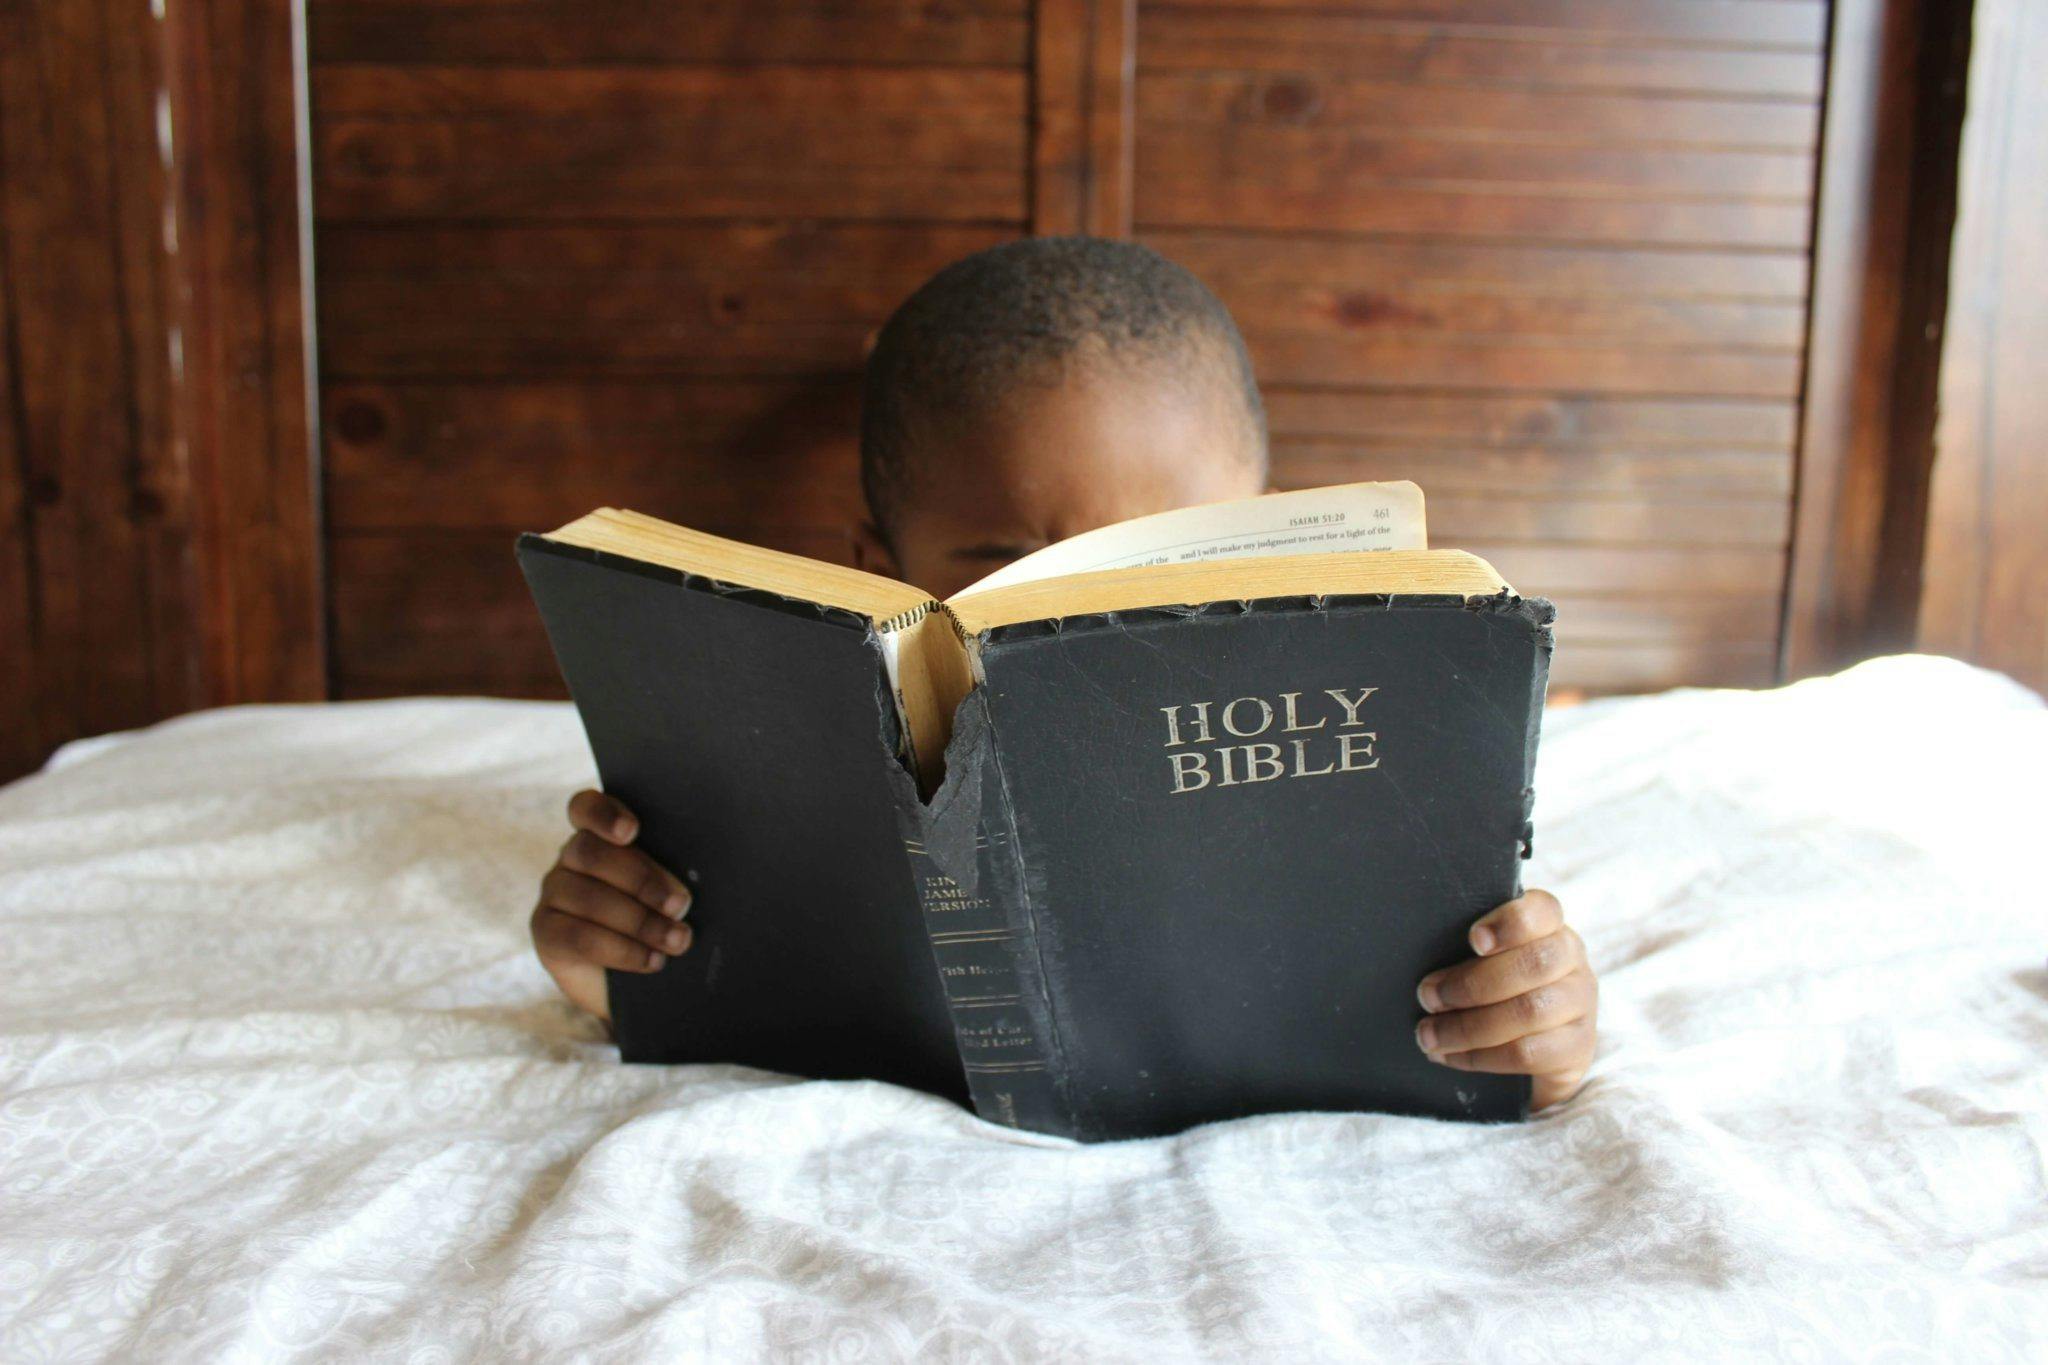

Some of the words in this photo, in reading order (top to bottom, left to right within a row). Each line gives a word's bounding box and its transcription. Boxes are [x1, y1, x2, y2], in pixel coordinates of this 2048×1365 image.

[1289, 515, 1319, 527] ISAIAH
[1322, 512, 1346, 523] 51:20
[1373, 507, 1390, 519] 461
[1180, 549, 1196, 560] and
[1202, 545, 1218, 555] will
[1219, 543, 1242, 553] make
[1243, 543, 1256, 551] my
[1257, 536, 1297, 549] judgment
[1298, 535, 1308, 543] to
[1326, 530, 1338, 540] for
[1345, 528, 1366, 540] light
[1367, 526, 1376, 536] of
[1377, 525, 1391, 535] the
[1160, 687, 1379, 747] HOLY
[1167, 731, 1380, 794] BIBLE
[925, 876, 956, 887] KIN
[924, 889, 969, 900] JAME
